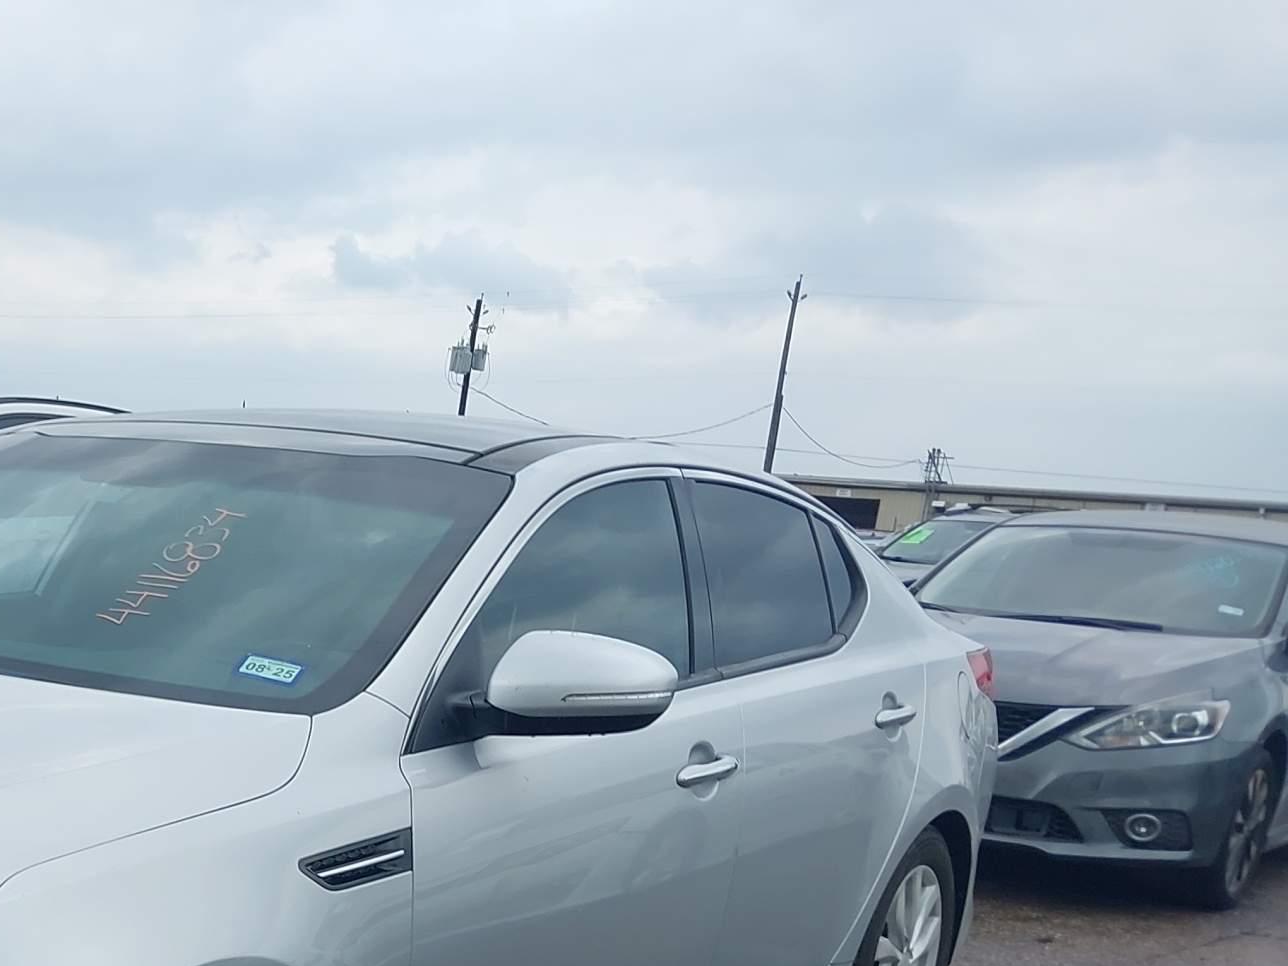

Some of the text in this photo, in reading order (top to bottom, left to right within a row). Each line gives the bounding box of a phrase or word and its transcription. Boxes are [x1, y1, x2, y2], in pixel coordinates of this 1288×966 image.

[96, 508, 247, 624] 44116834
[245, 662, 266, 673] 08
[272, 667, 296, 679] 25
